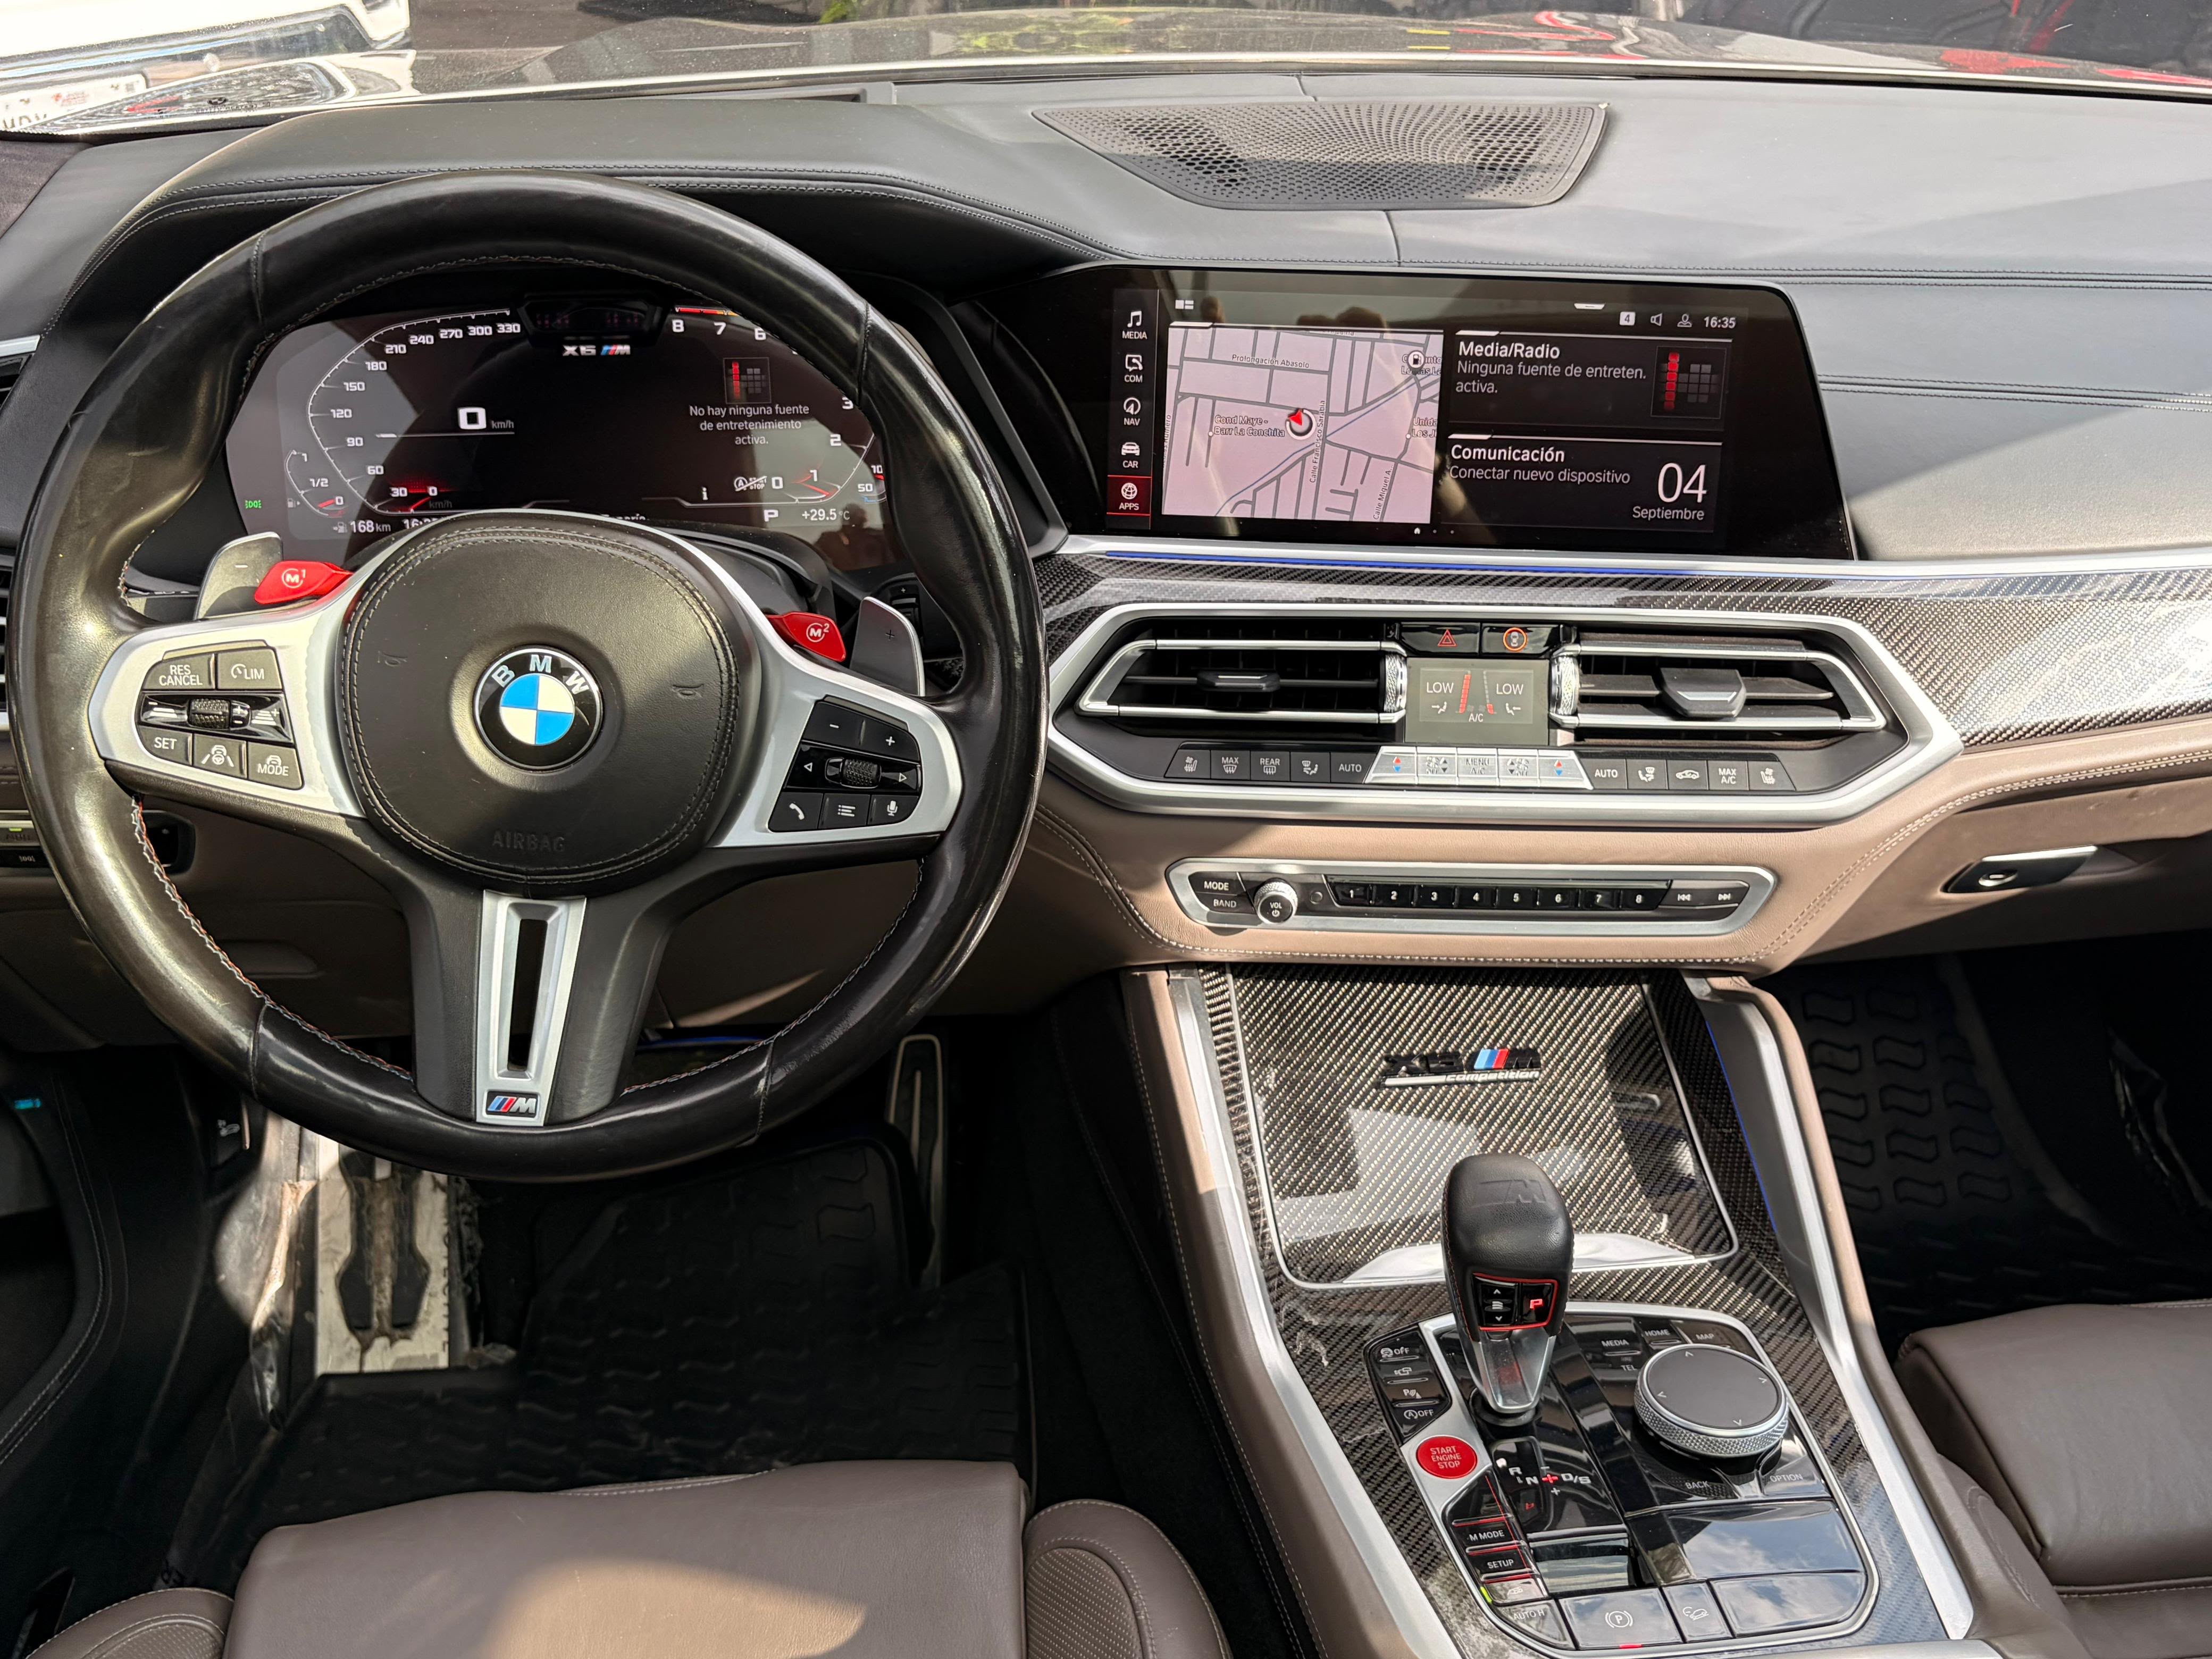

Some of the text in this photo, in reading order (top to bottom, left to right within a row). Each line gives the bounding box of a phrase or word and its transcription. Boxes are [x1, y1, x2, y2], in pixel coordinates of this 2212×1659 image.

[672, 320, 684, 333] 8
[1704, 316, 1736, 329] 16:35
[440, 328, 463, 339] 270
[468, 325, 492, 337] 300
[497, 323, 520, 334] 330
[714, 322, 726, 335] 7
[755, 328, 766, 340] 6
[410, 334, 434, 346] 240
[1122, 331, 1147, 340] MEDIA
[385, 343, 407, 355] 210
[562, 345, 596, 356] X6
[1459, 341, 1560, 359] Media/Radio
[365, 361, 388, 371] 180
[1232, 354, 1310, 368] Prolongación Abasolo
[1457, 361, 1646, 379] Ninguna fuente de entreten.
[343, 381, 365, 392] 150
[1455, 380, 1498, 393] activa.
[842, 397, 853, 409] 3
[330, 408, 352, 419] 120
[689, 404, 810, 418] No hay ninguna fuente
[1317, 400, 1326, 429] Sarabia
[457, 407, 514, 430] 0 km/h
[1215, 415, 1238, 425] Cond
[1239, 416, 1263, 427] Maye
[700, 419, 802, 431] de entretenimiento
[1214, 426, 1234, 435] Barr
[1235, 427, 1245, 436] La
[347, 437, 364, 447] 90
[735, 435, 769, 445] activa.
[830, 434, 842, 447] 2
[1312, 430, 1323, 464] Francisco
[1451, 443, 1565, 463] Comunicación
[1122, 460, 1138, 468] CAR
[367, 465, 384, 475] 60
[1449, 465, 1630, 486] Conectar nuevo dispositivo
[810, 470, 817, 482] 1
[309, 479, 329, 488] 1/2
[771, 476, 783, 489] 0
[1657, 462, 1707, 503] 04
[390, 487, 408, 498] 30
[429, 487, 438, 496] 0
[1373, 501, 1382, 520] Calle
[1378, 474, 1390, 501] Miguel
[335, 496, 343, 505] 0
[1119, 502, 1139, 510] APPS
[764, 509, 779, 522] P
[802, 508, 837, 522] +29.5
[1632, 506, 1705, 521] Septiembre
[350, 521, 391, 533] 168 km
[170, 664, 191, 675] RES
[244, 668, 265, 680] LIM
[491, 653, 590, 695] BMW
[159, 675, 203, 686] CANCEL
[1426, 682, 1454, 694] LOW
[1496, 683, 1524, 696] LOW
[1469, 713, 1484, 723] A/C
[154, 737, 177, 750] SET
[1221, 757, 1239, 766] MAX
[1260, 757, 1280, 766] REAR
[1465, 757, 1489, 766] MENU
[257, 764, 289, 776] MODE
[1338, 763, 1362, 773] AUTO
[1595, 769, 1618, 778] AUTO
[1721, 776, 1736, 784] A/C
[492, 830, 565, 852] AIRBAG
[1204, 881, 1230, 891] MODE
[1350, 890, 1355, 899] 1
[1390, 891, 1397, 900] 2
[1431, 892, 1438, 901] 3
[1472, 892, 1480, 902] 4
[1513, 893, 1520, 903] 5
[1555, 894, 1562, 903] 6
[1596, 894, 1603, 904] 7
[1636, 894, 1643, 904] 8
[1213, 899, 1237, 908] BAND
[1269, 901, 1283, 910] VOL
[1529, 1298, 1544, 1310] P
[1394, 1346, 1410, 1355] OFF
[1418, 1409, 1435, 1418] OFF
[1430, 1445, 1457, 1455] START
[1430, 1452, 1462, 1462] ENGINE
[1437, 1460, 1461, 1470] STOP
[1508, 1466, 1522, 1476] R
[1525, 1476, 1539, 1485] N
[1561, 1472, 1592, 1485] D/S
[1770, 1472, 1804, 1484] OPTION
[1685, 1480, 1710, 1490] BACK
[1469, 1529, 1505, 1541] M MODE
[1487, 1559, 1514, 1569] SETUP
[1513, 1608, 1545, 1620] AUTO H
